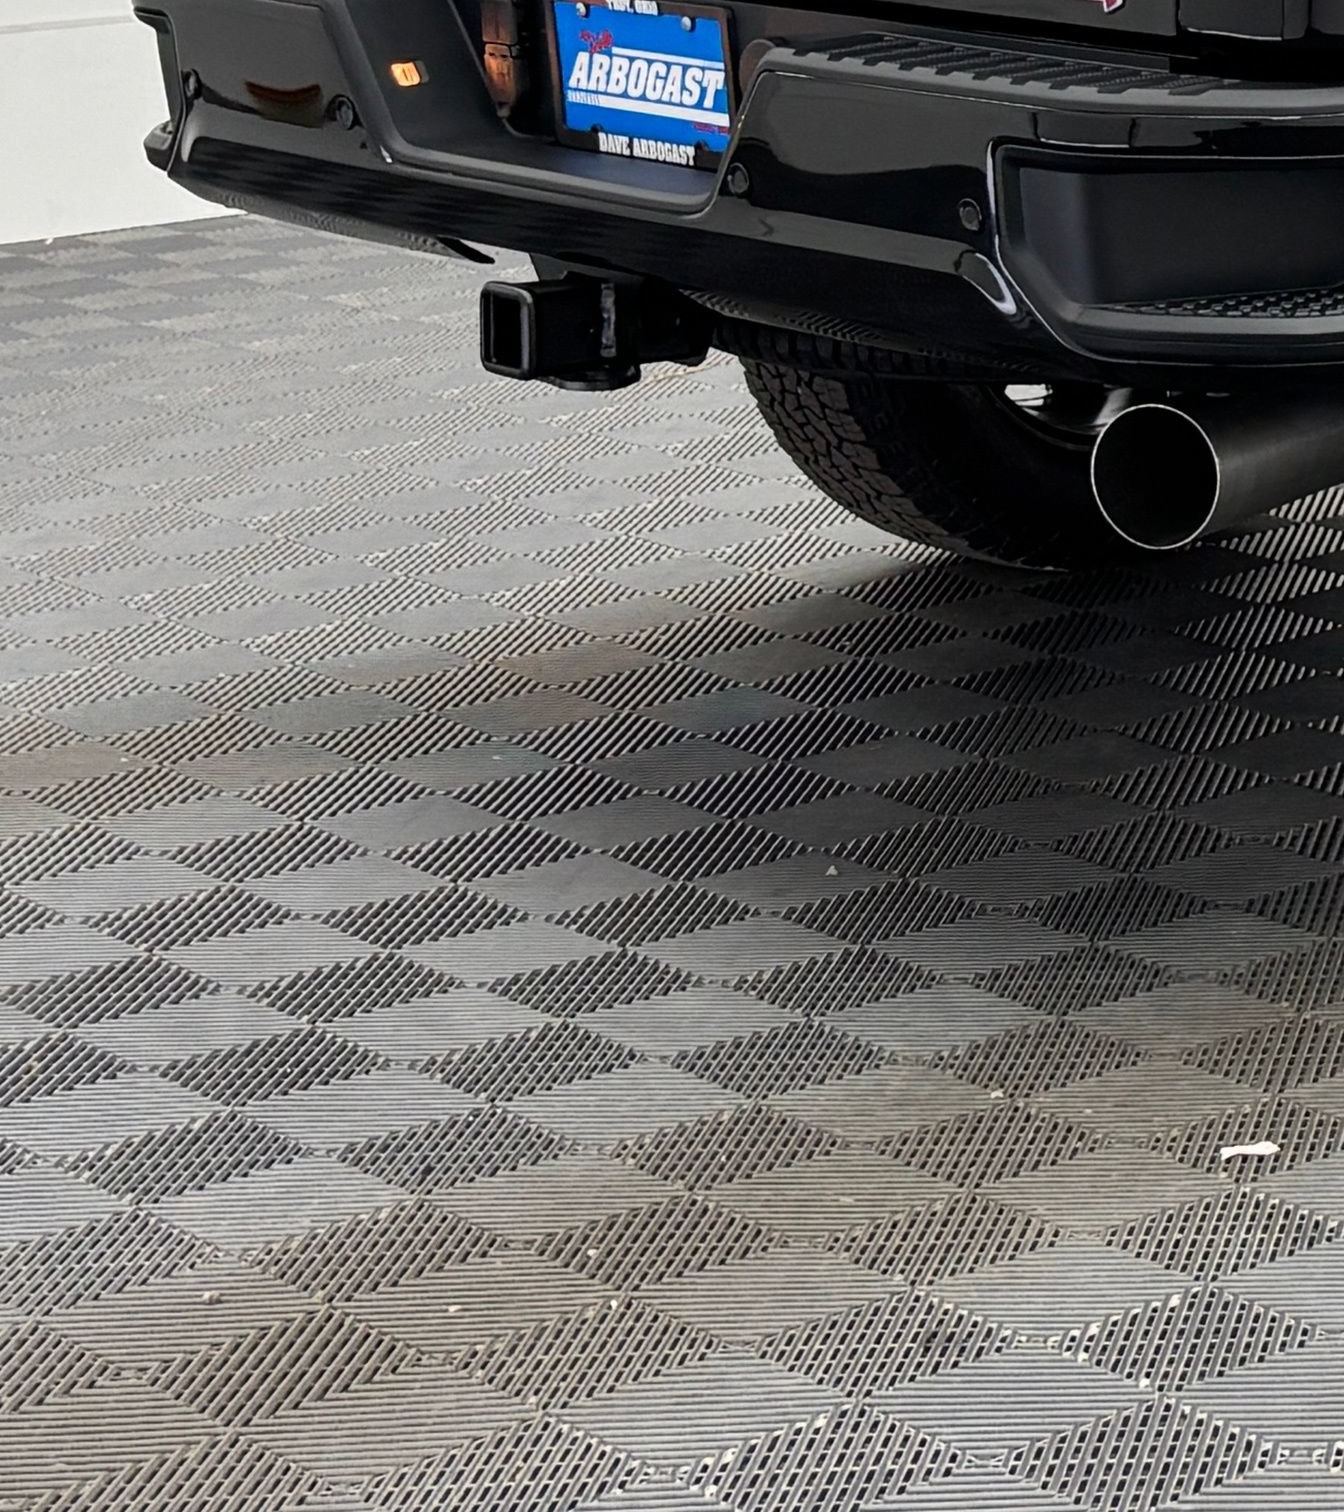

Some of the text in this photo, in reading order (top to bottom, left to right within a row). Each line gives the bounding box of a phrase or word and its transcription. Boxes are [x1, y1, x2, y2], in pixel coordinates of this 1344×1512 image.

[568, 50, 726, 109] ARBOGAST
[598, 132, 696, 166] DAVE ARBOGAST
